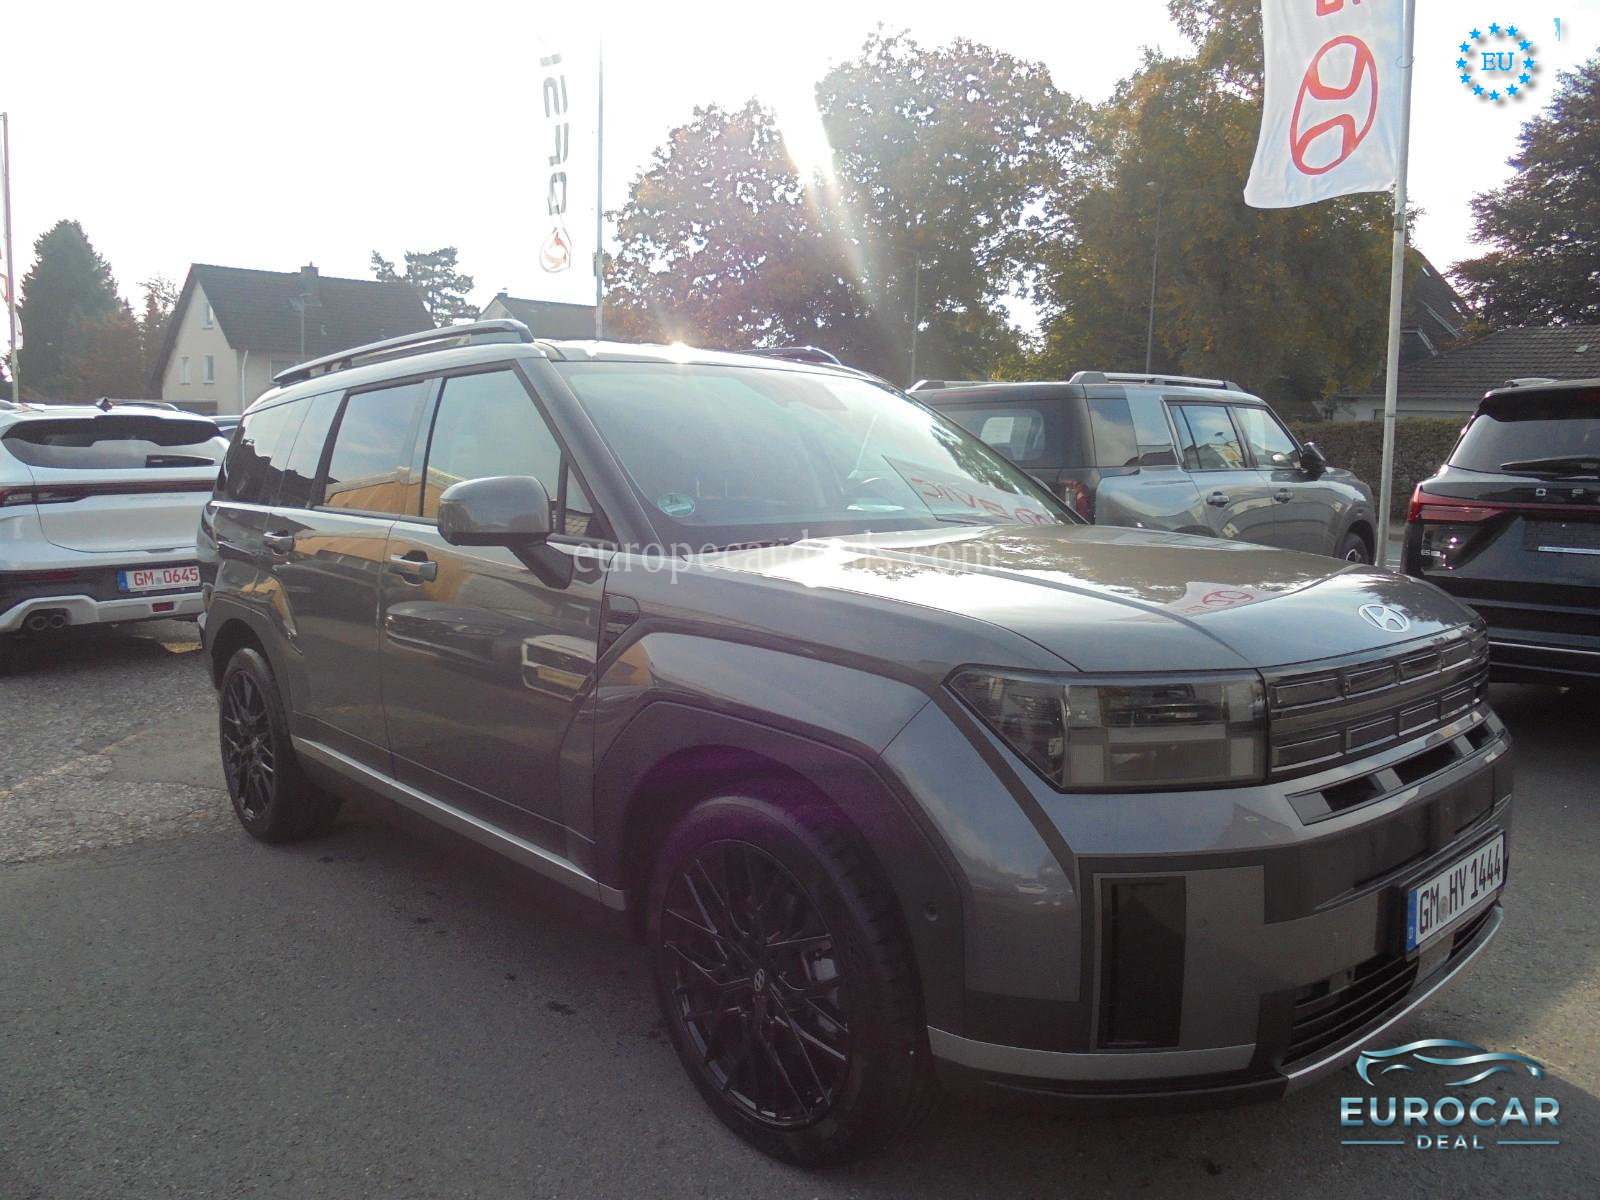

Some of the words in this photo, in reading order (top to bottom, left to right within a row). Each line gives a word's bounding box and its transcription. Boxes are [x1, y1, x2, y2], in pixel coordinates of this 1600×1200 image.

[133, 571, 155, 586] GM
[162, 567, 199, 584] 0645
[1419, 883, 1440, 935] GM
[1449, 864, 1467, 915] HY
[1470, 843, 1501, 899] 1444
